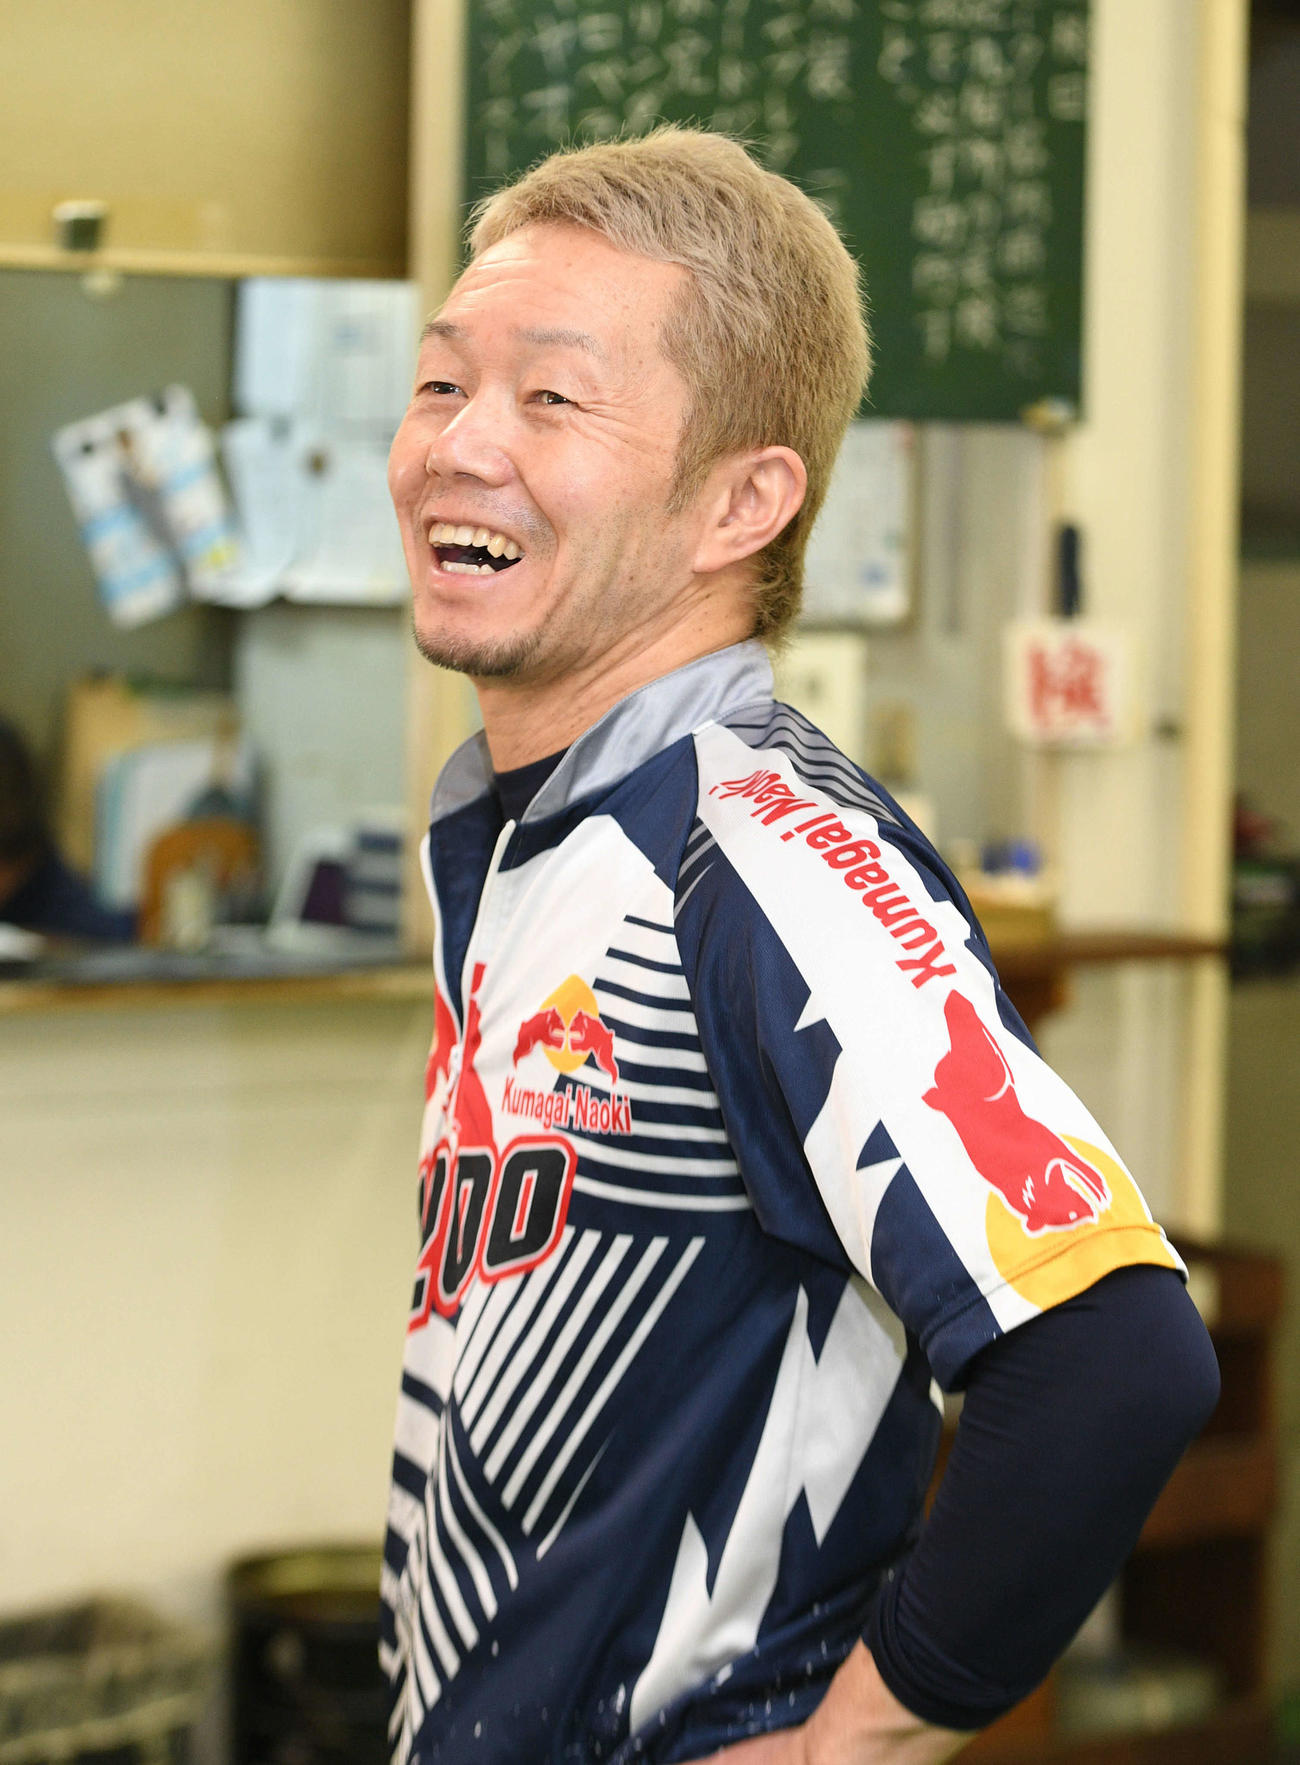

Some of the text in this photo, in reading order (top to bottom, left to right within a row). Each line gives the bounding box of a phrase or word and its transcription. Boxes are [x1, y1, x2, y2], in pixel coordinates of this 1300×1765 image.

[708, 769, 957, 989] Kumagai Naoki
[502, 1076, 632, 1134] Kumagai Naoki
